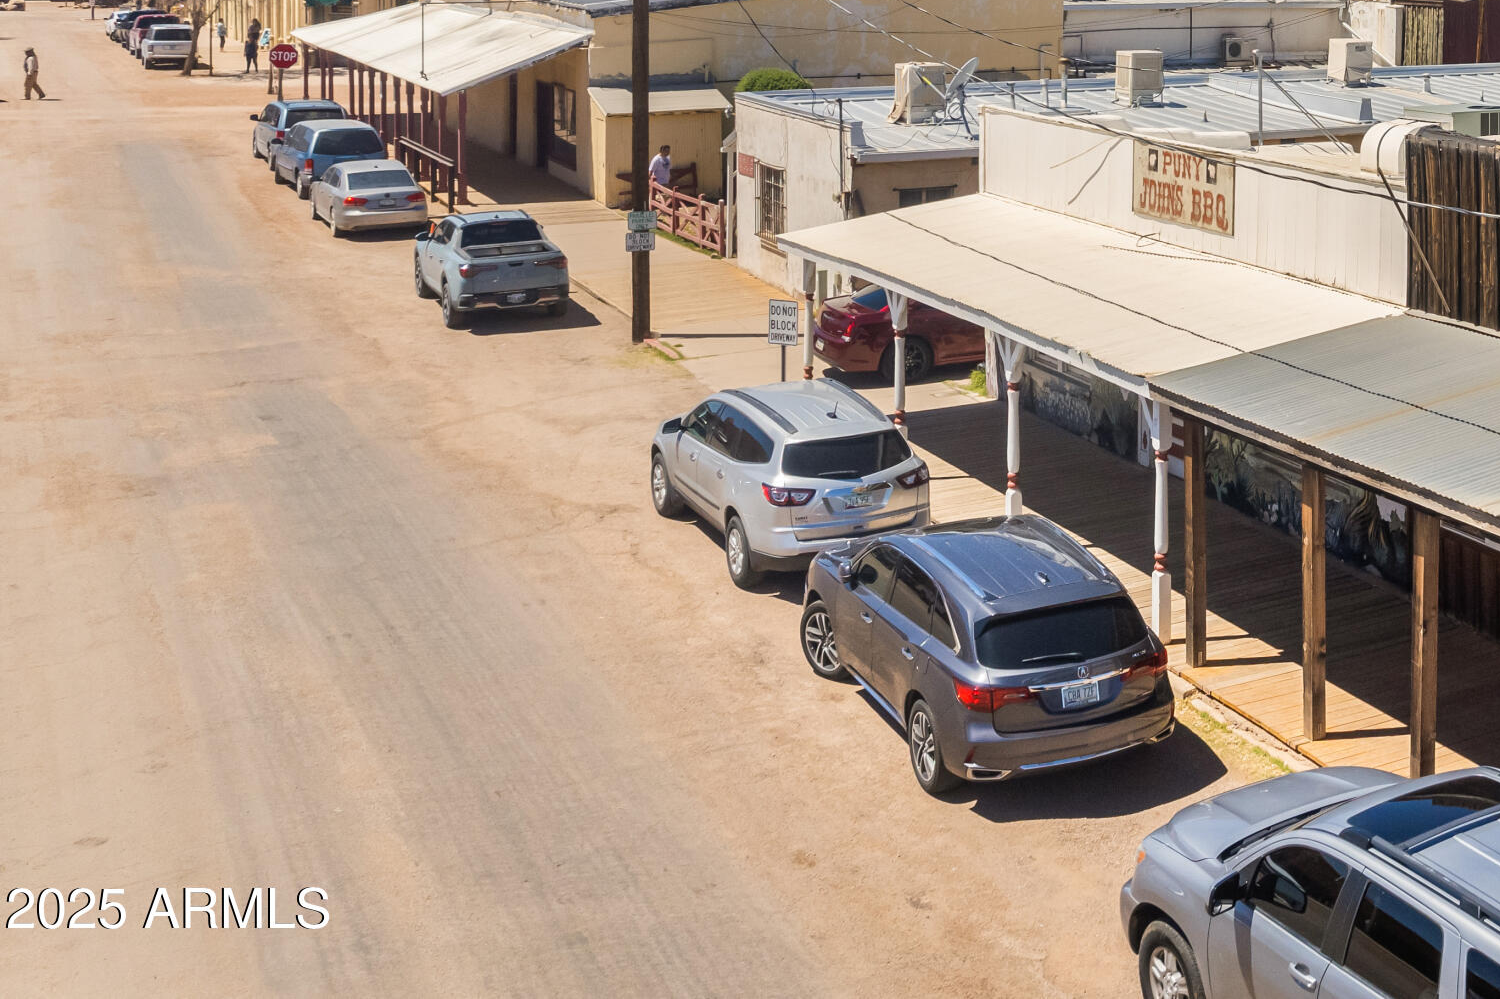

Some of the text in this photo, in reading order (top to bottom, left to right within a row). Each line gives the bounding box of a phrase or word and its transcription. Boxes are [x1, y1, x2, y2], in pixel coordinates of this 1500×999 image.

[270, 51, 297, 61] STOP
[1162, 150, 1202, 181] PUNY
[1190, 187, 1229, 231] BBQ
[770, 305, 797, 317] DO NOT
[770, 320, 797, 331] BLOCK
[770, 333, 796, 342] DRIVEWAY
